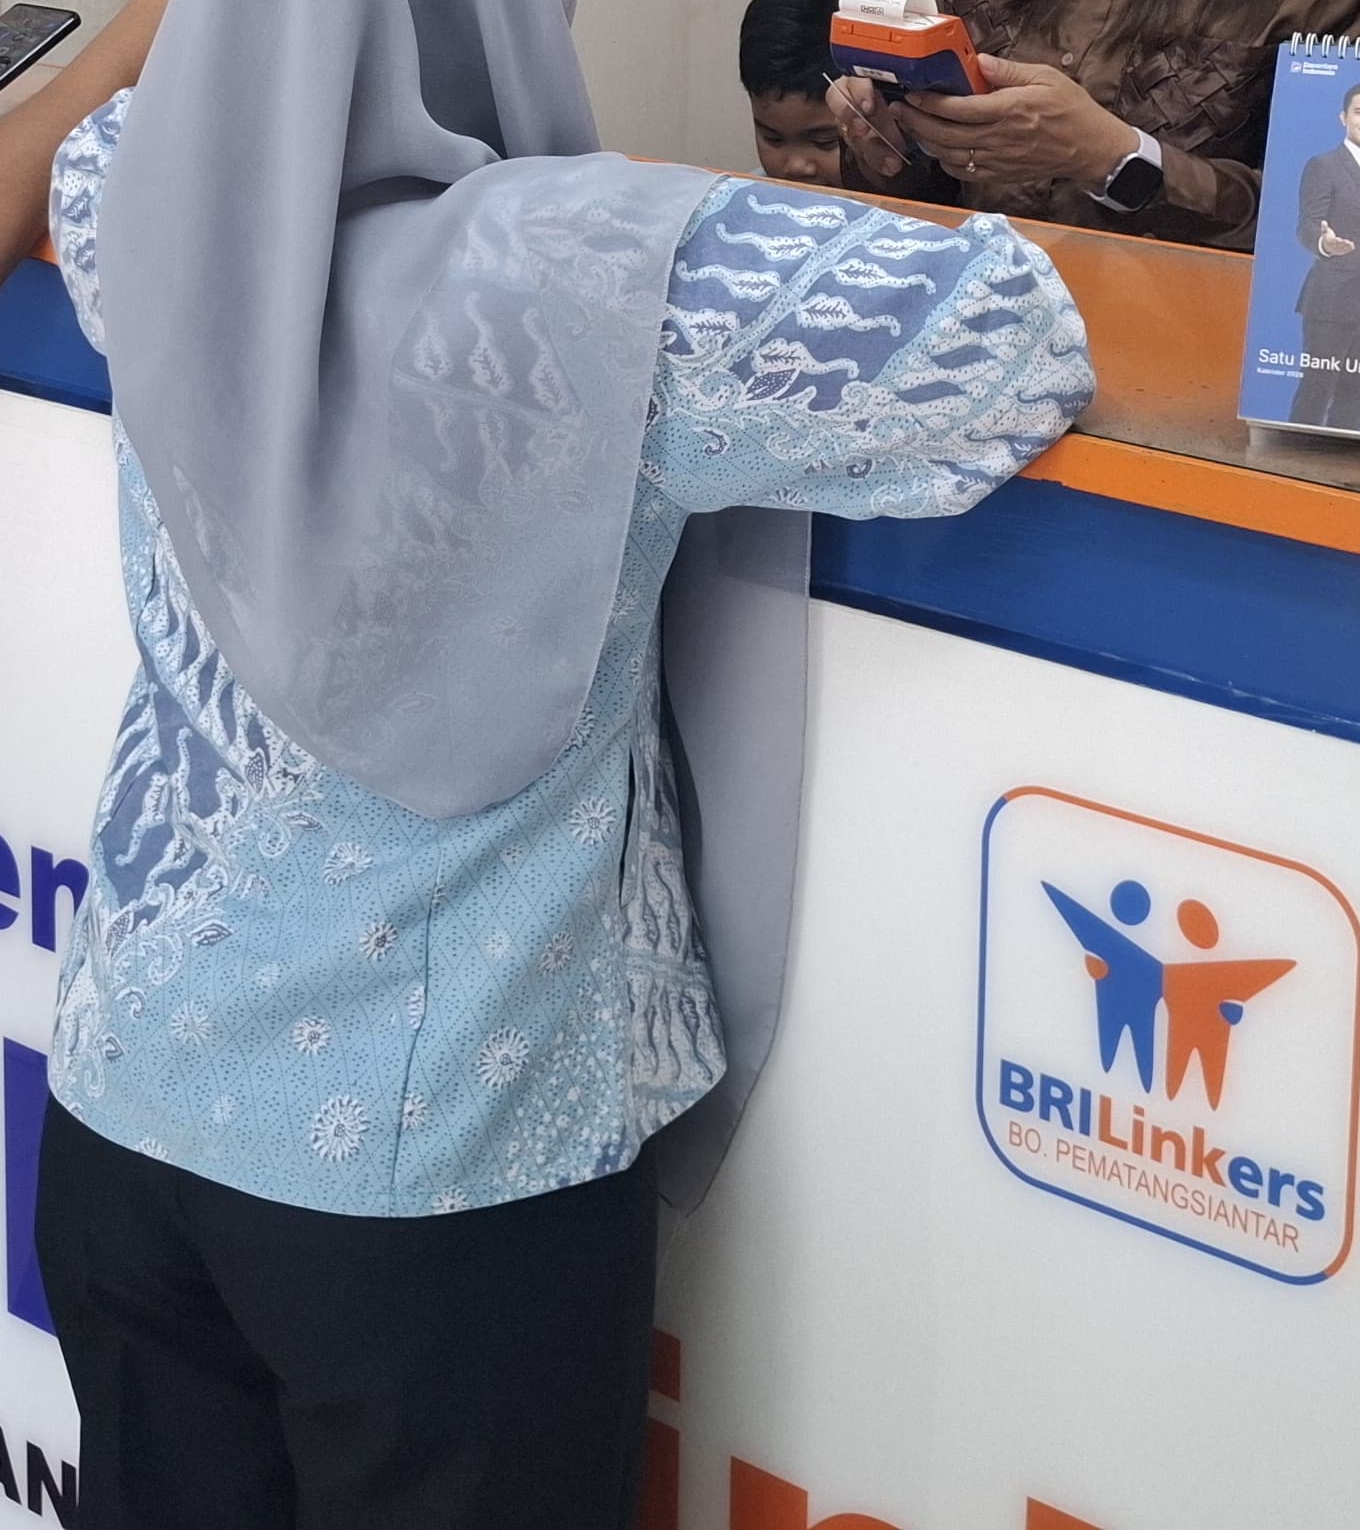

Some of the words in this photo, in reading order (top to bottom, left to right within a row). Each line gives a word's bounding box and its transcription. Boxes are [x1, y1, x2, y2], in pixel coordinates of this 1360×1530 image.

[1258, 348, 1295, 366] Satu
[1300, 352, 1341, 372] Bank
[998, 1057, 1326, 1222] BRILinkers
[1007, 1119, 1048, 1160] BO.
[1055, 1137, 1300, 1254] PEMATANGSIANTAR
